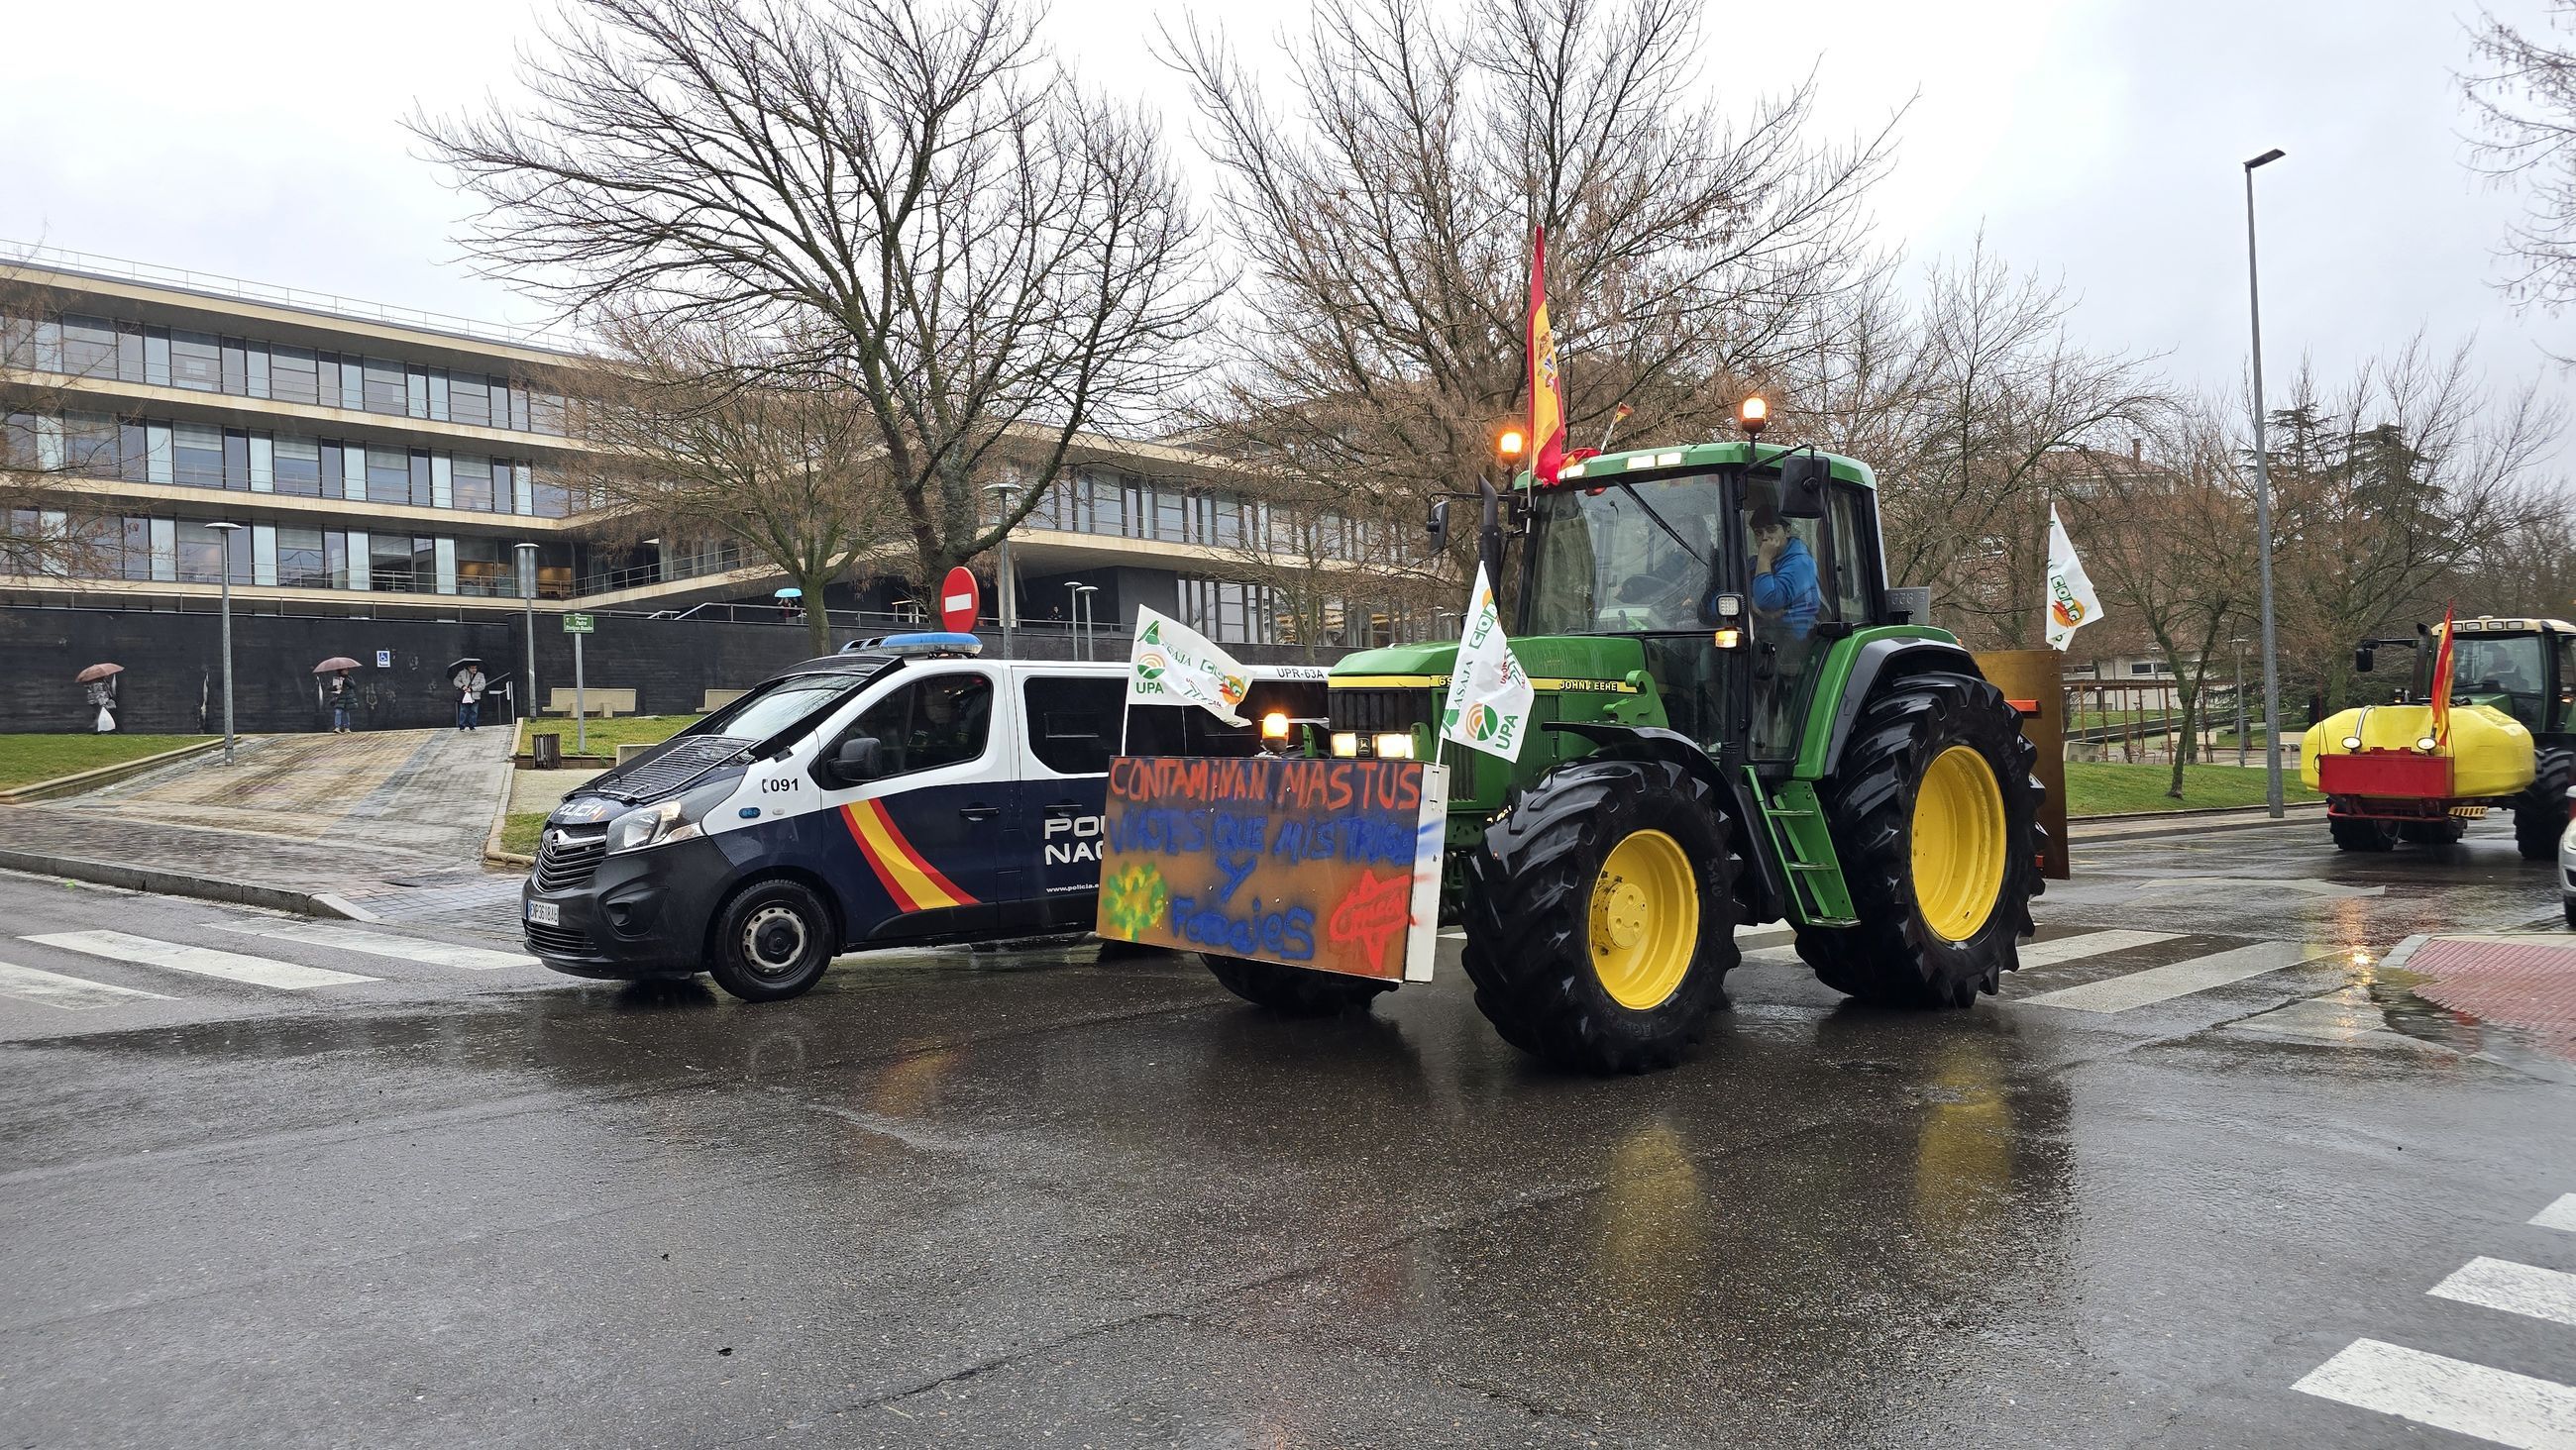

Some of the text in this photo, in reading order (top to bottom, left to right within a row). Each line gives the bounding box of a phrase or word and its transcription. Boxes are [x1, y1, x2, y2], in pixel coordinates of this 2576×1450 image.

[2051, 575, 2083, 621] COAG
[1276, 668, 1325, 679] UPR-63A
[1136, 681, 1164, 694] UPA
[1454, 661, 1473, 708] ASAJA
[1559, 679, 1586, 690] JOHN
[1495, 715, 1519, 750] UPA
[770, 777, 799, 792] 091
